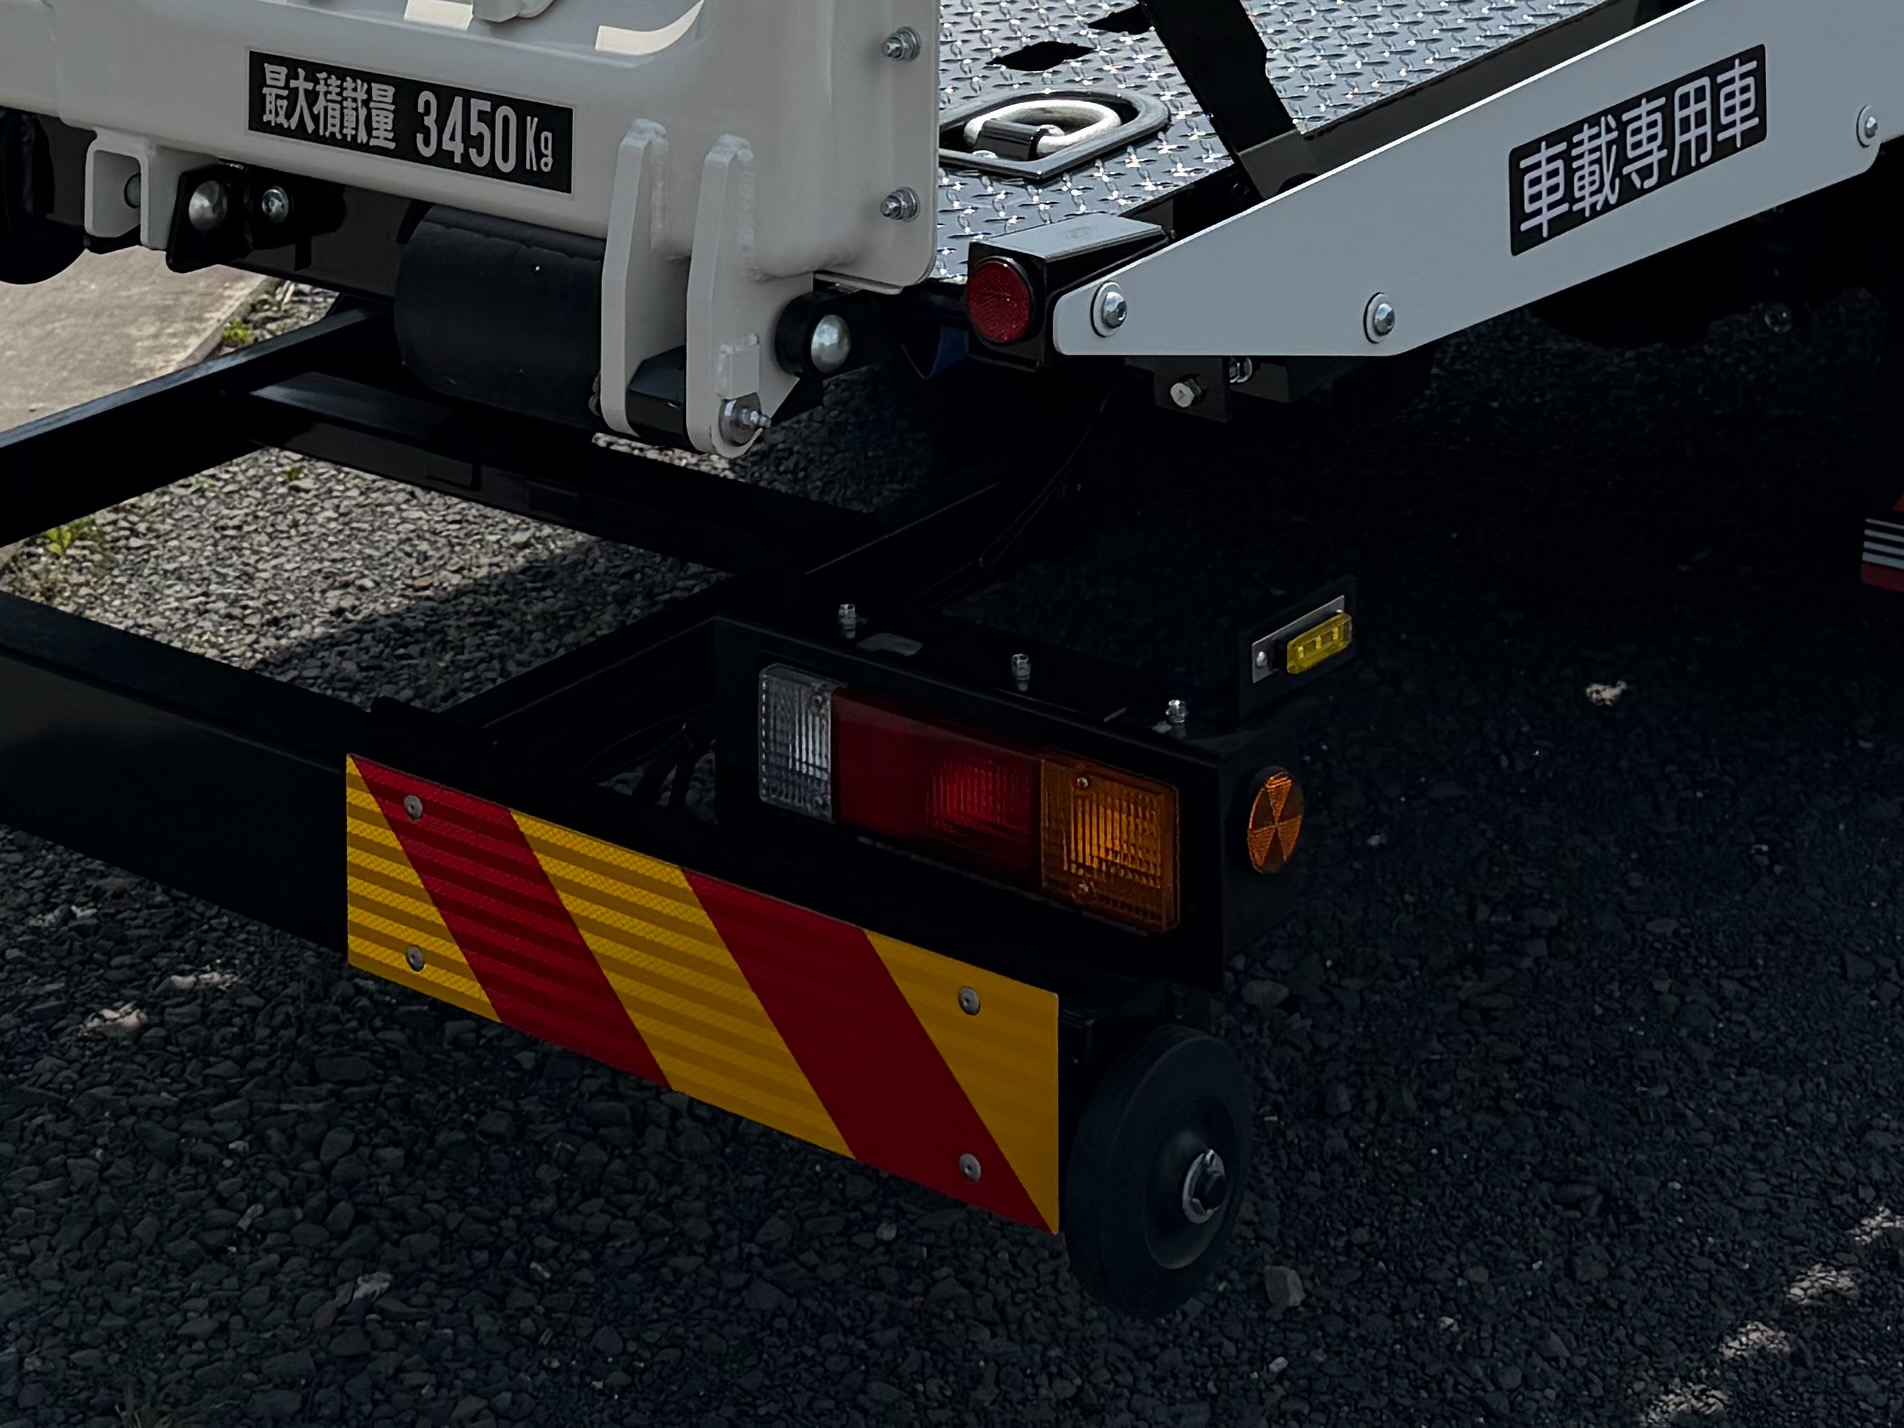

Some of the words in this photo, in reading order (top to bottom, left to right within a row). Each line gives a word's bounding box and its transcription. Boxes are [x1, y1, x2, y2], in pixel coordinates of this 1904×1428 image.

[262, 62, 396, 150] 最大積載量
[1519, 58, 1760, 238] 車載専用車
